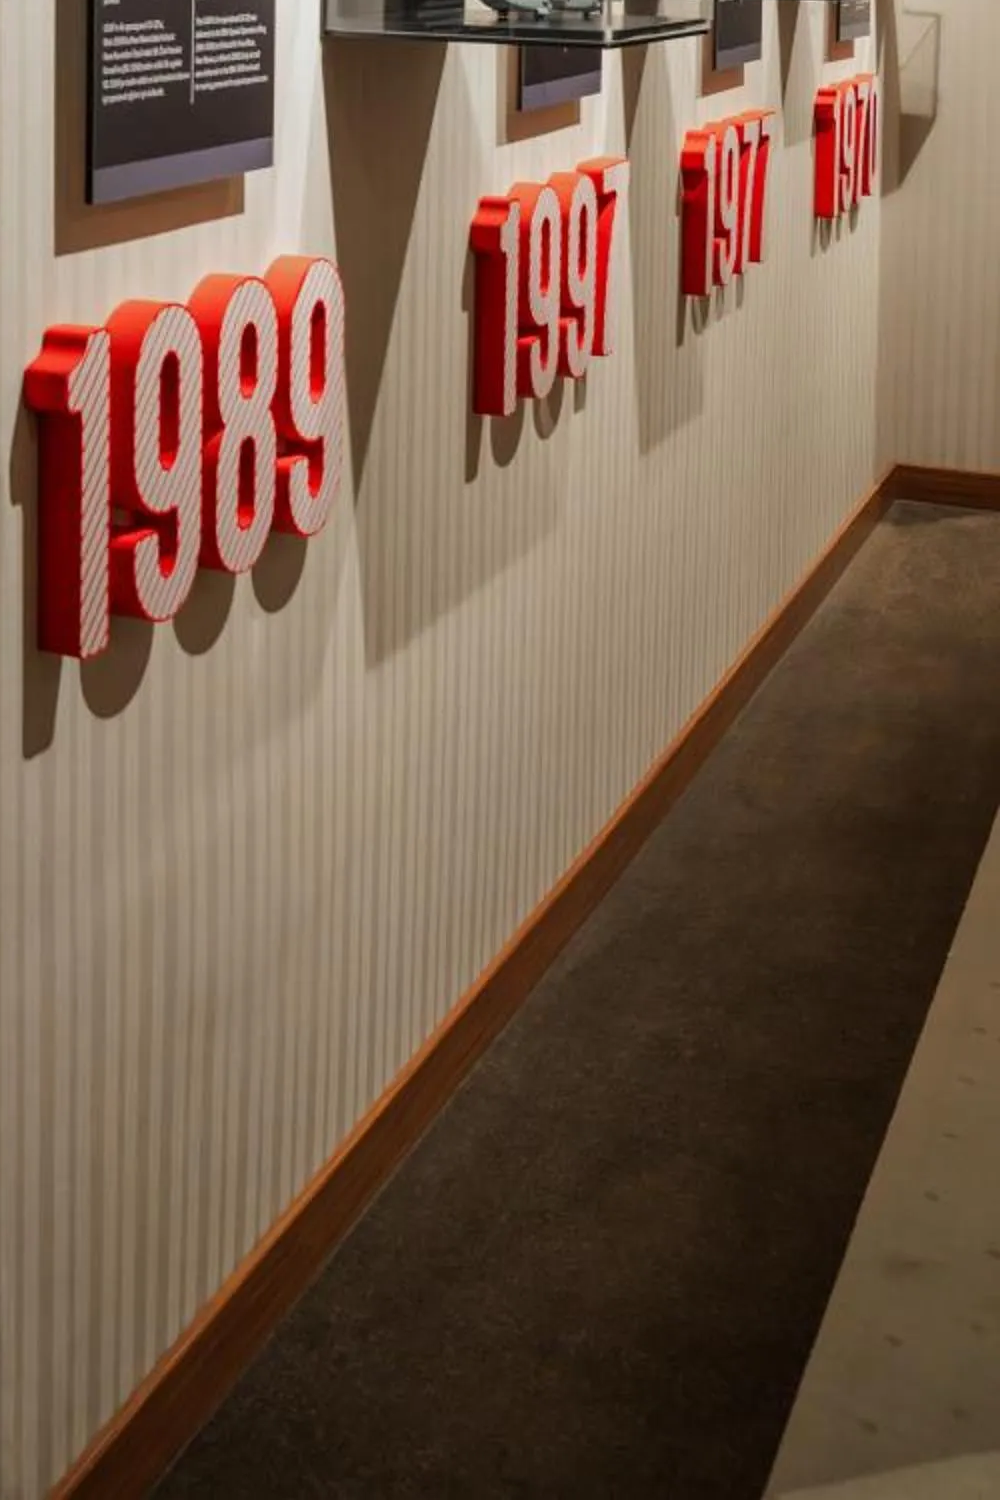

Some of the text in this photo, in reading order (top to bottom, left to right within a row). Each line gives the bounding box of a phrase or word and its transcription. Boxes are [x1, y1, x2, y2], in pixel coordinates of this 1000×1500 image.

[679, 107, 776, 297] 1977
[814, 73, 880, 220] 1970
[469, 156, 631, 417] 1997
[23, 254, 345, 659] 1989
